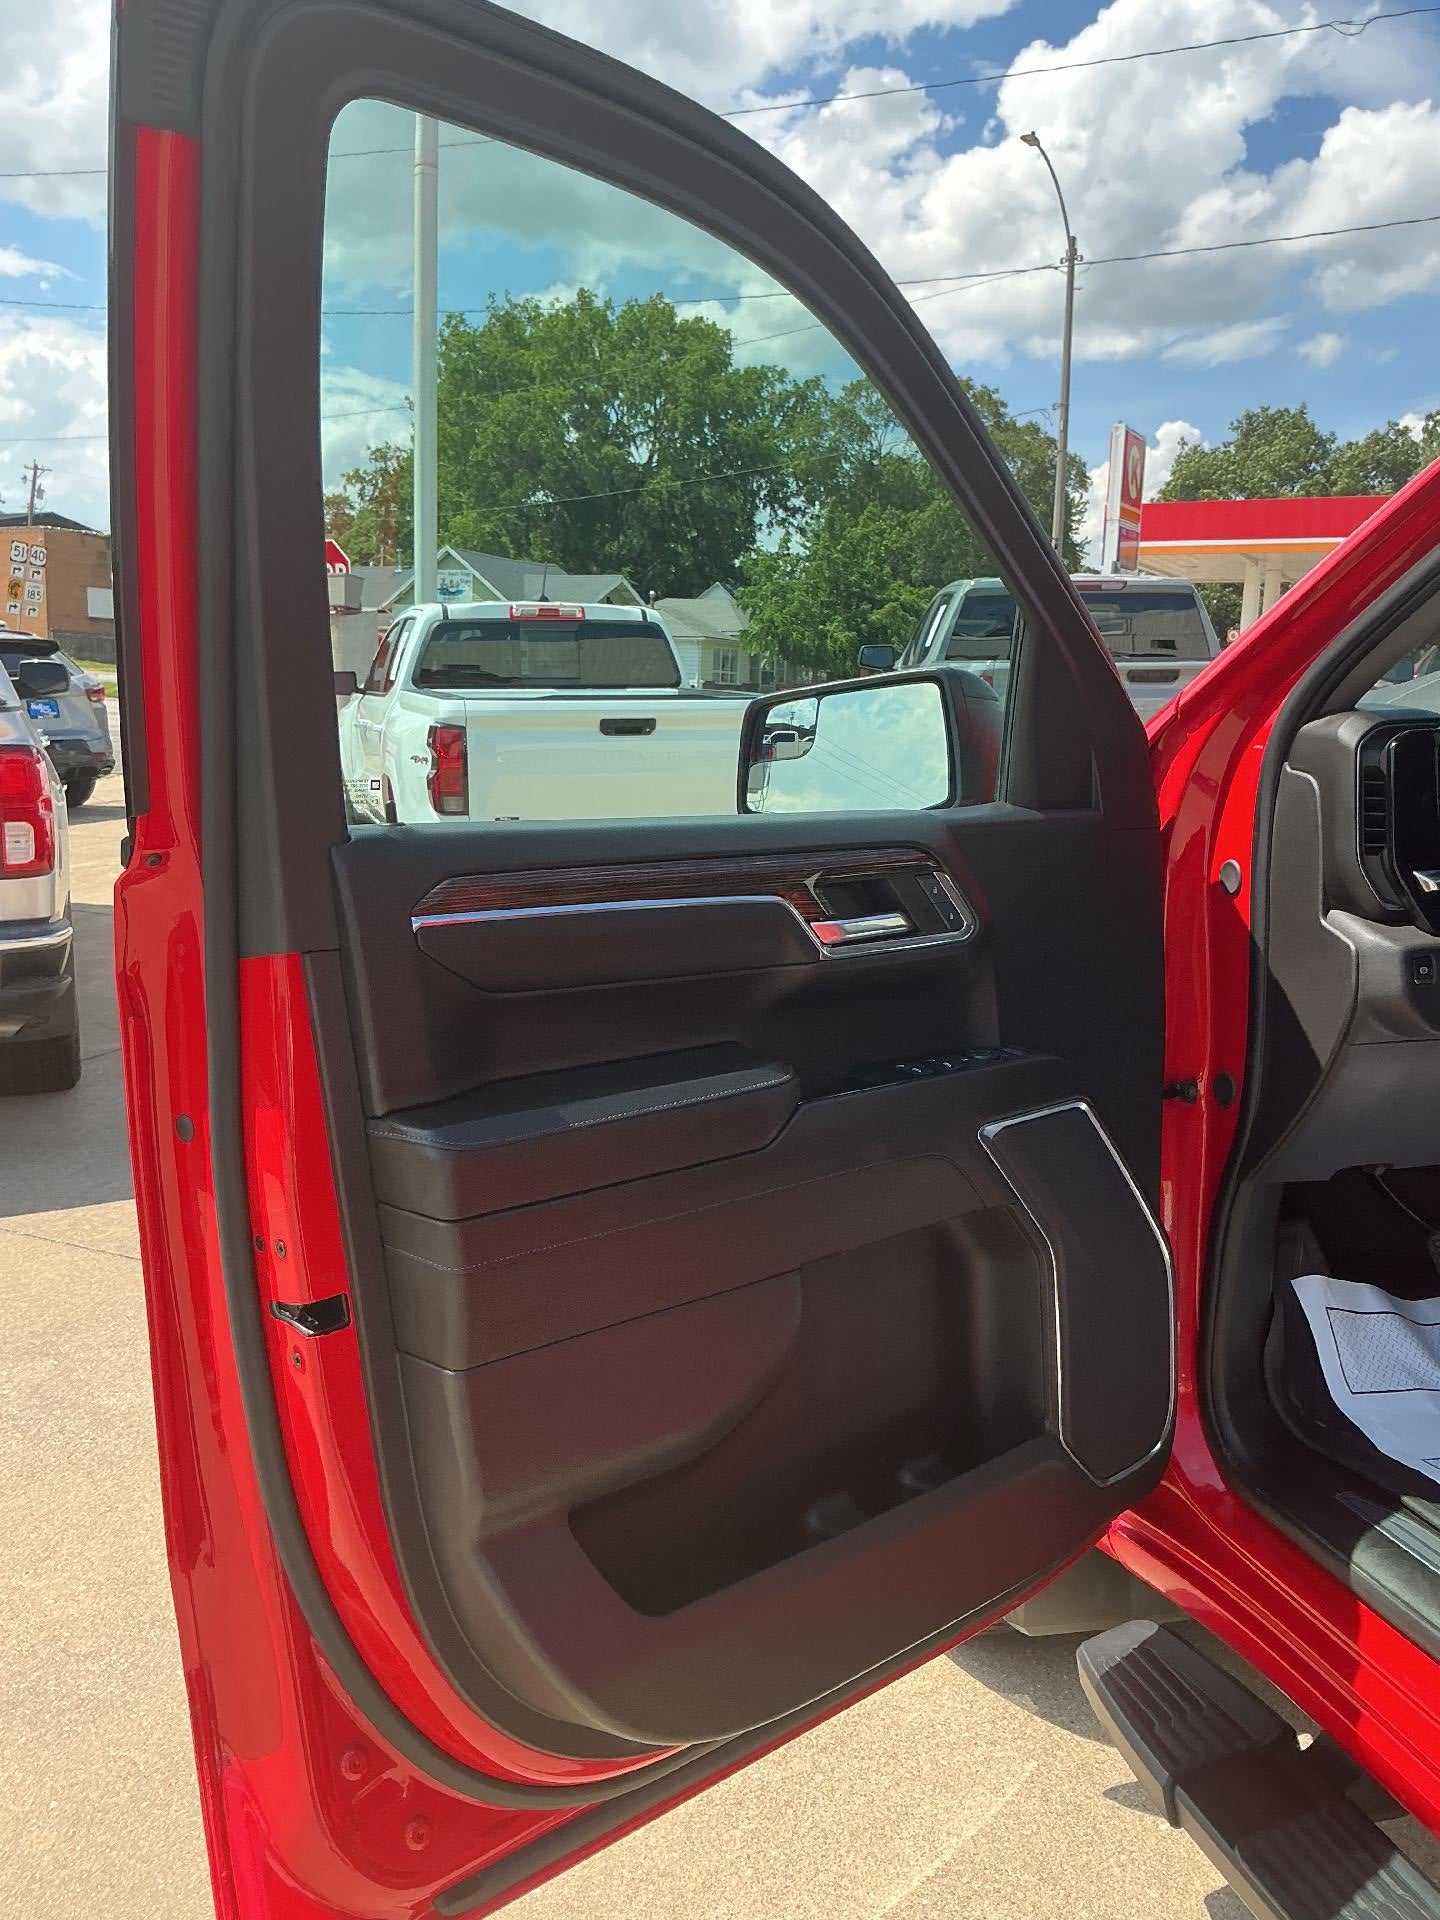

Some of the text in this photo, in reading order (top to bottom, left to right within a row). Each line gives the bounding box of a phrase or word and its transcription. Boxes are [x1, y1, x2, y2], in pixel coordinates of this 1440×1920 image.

[14, 545, 25, 558] 51
[31, 550, 45, 562] 40
[26, 588, 42, 601] 185
